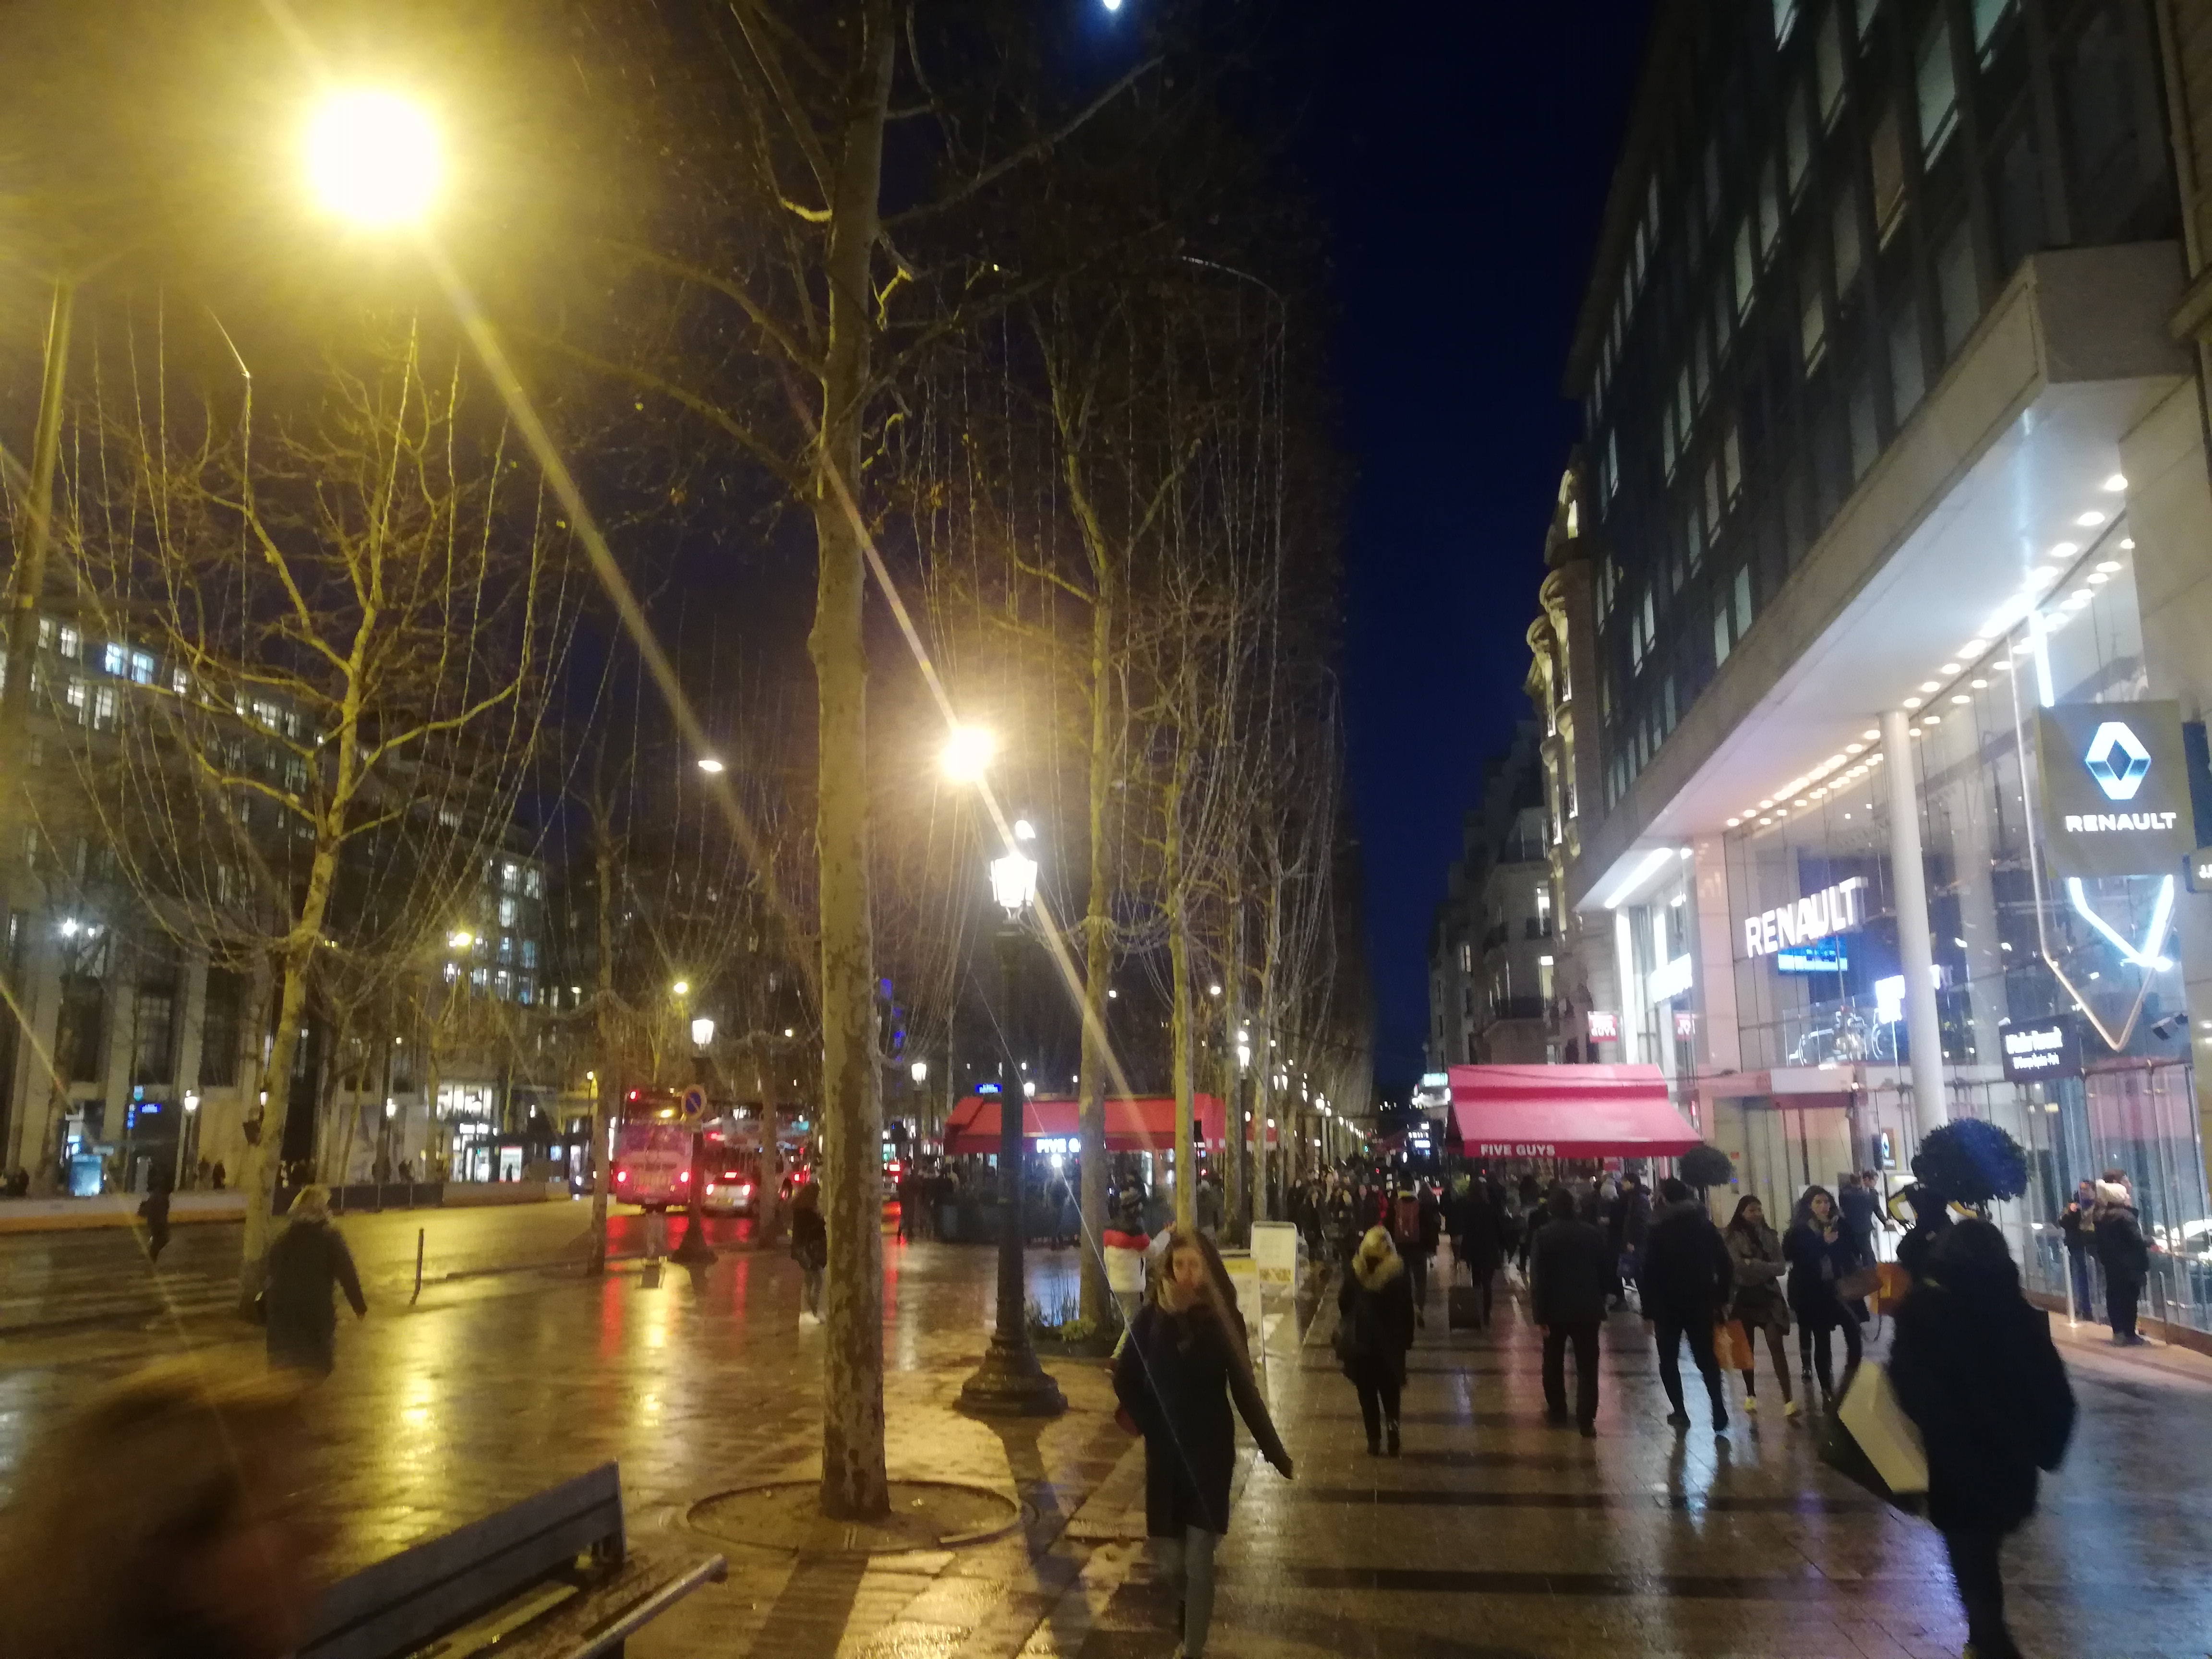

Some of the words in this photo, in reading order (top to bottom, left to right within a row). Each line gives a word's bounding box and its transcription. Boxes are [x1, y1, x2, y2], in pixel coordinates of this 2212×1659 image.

[2065, 812, 2176, 832] RENAULT
[1744, 877, 1859, 959] RENAULT
[1480, 1144, 1512, 1156] FIVE
[1516, 1144, 1555, 1156] GUYS
